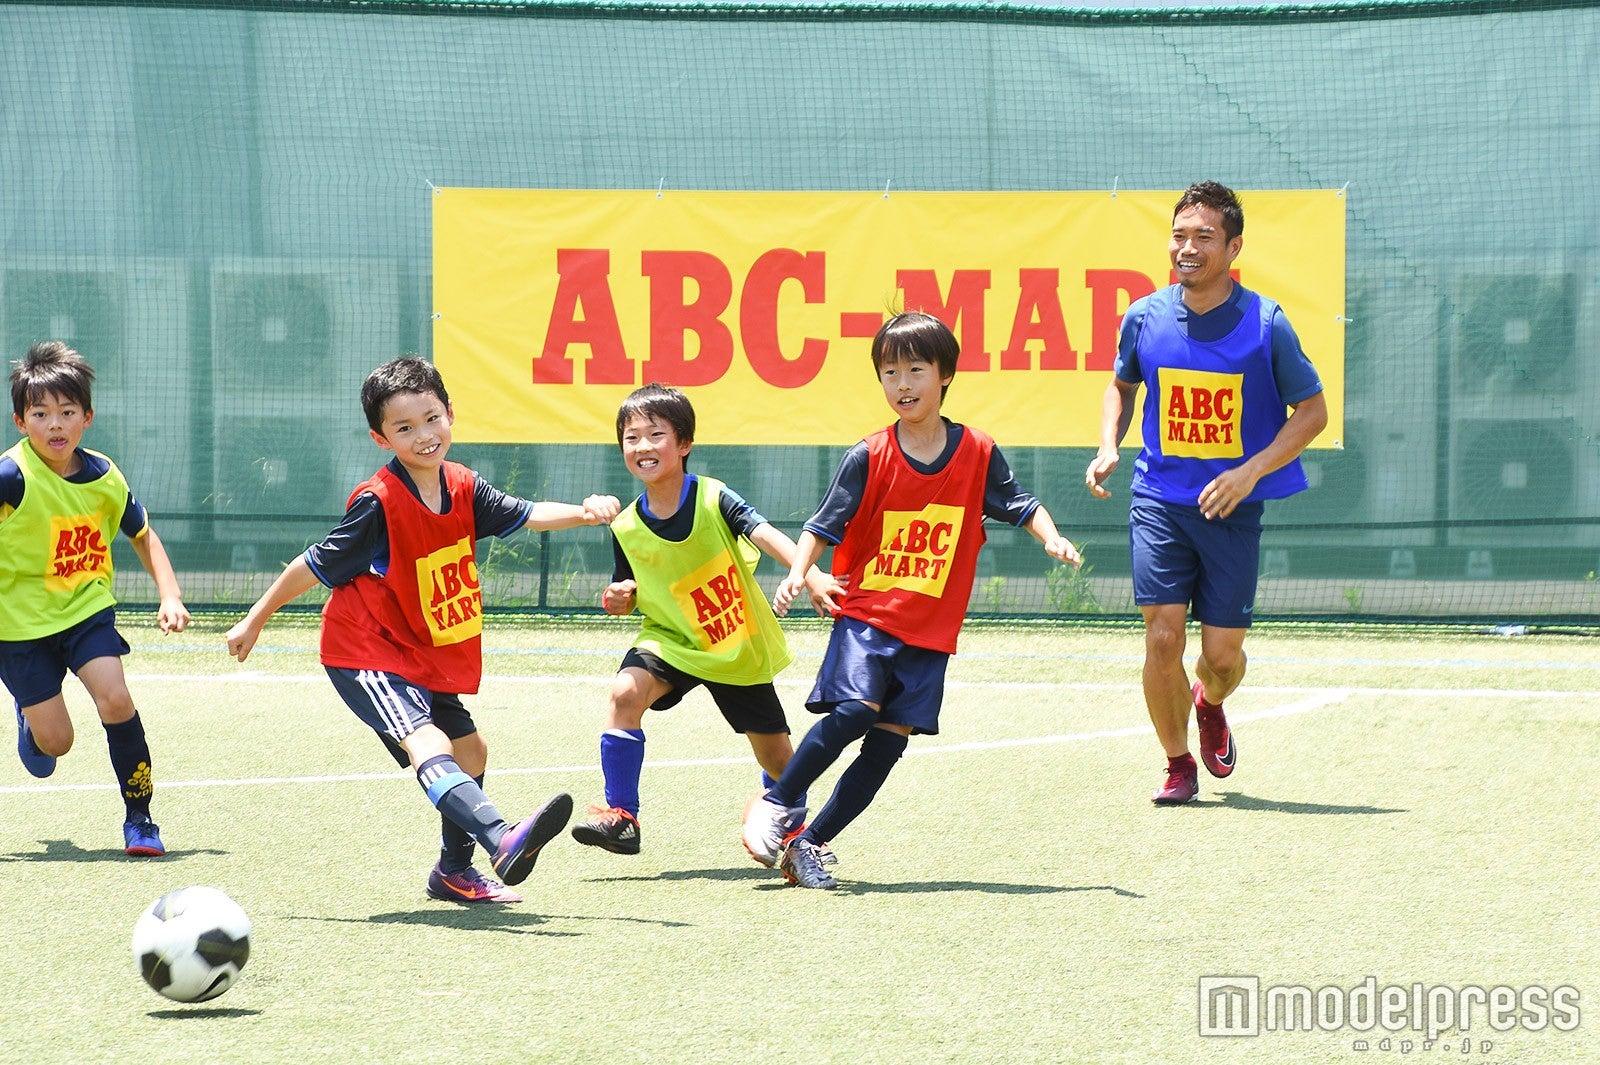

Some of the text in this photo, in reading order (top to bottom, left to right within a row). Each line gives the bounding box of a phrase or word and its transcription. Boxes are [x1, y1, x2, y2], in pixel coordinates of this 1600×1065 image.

[532, 247, 1241, 389] ABC-MAR
[1168, 385, 1234, 421] ABC
[1168, 420, 1234, 445] MART
[54, 525, 108, 561] ABC
[873, 553, 947, 580] MART
[702, 600, 745, 645] MAR
